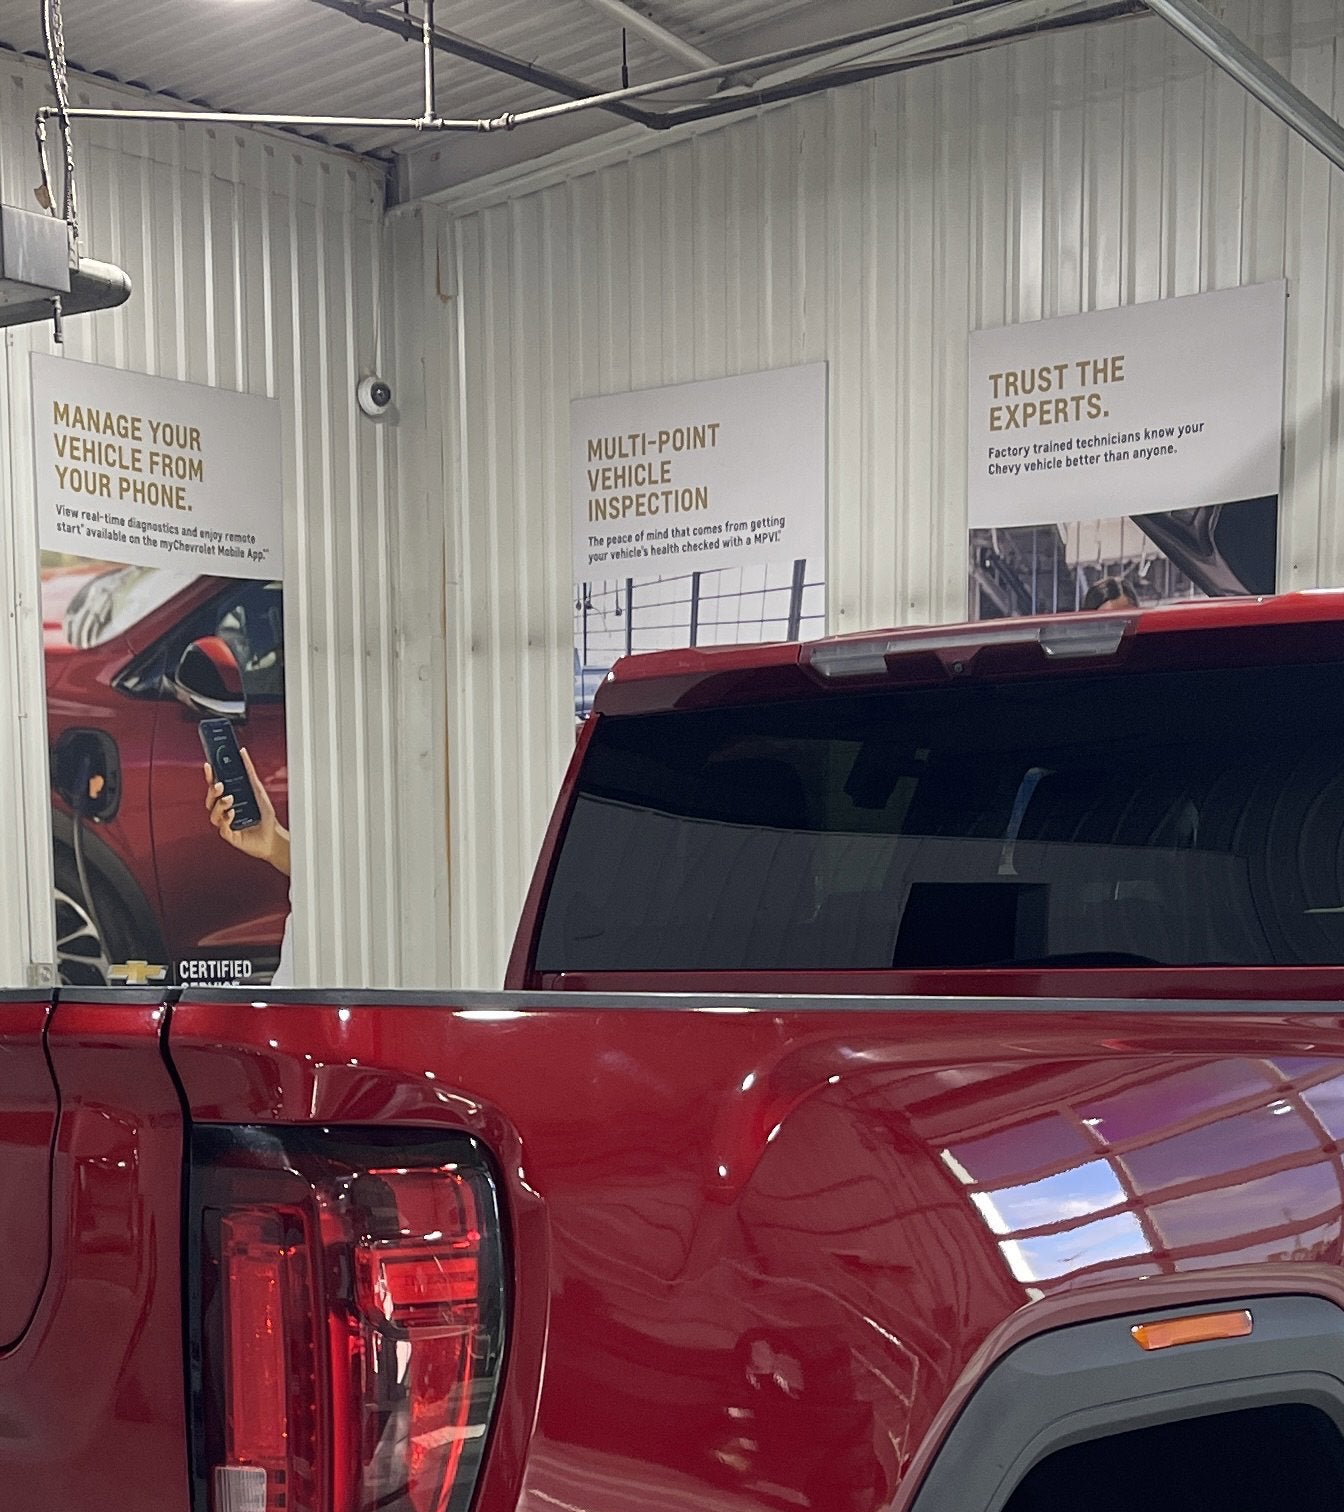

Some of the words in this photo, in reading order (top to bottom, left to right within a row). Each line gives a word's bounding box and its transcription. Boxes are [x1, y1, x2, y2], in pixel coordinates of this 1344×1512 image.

[988, 363, 1069, 399] TRUST
[1075, 355, 1125, 386] THE
[53, 401, 142, 442] MANAGE
[148, 419, 202, 451] YOUR
[989, 392, 1110, 432] EXPERTS.
[53, 432, 143, 473] VEHICLE
[149, 450, 203, 483] FROM
[587, 422, 720, 462] MULTI-POINT
[988, 444, 1030, 461] Factory
[1033, 438, 1073, 455] trained
[1076, 429, 1141, 451] technicians
[1144, 425, 1175, 443] know
[1177, 421, 1205, 439] your
[988, 462, 1021, 476] Chevy
[1024, 455, 1062, 472] vehicle
[1065, 452, 1100, 468] better
[1104, 448, 1130, 464] than
[1132, 442, 1178, 460] anyone.
[55, 464, 111, 498] YOUR
[119, 476, 193, 512] PHONE.
[587, 460, 672, 492] VEHICLE
[588, 486, 708, 522] INSPECTION
[56, 504, 79, 519] View
[81, 509, 125, 527] real-time
[127, 516, 179, 536] diagnostics
[181, 526, 198, 539] and
[200, 529, 223, 544] enjoy
[225, 532, 256, 545] remote
[86, 526, 127, 544] available
[129, 535, 141, 545] on
[142, 535, 158, 548] the
[160, 538, 216, 556] myChevrolet
[218, 544, 245, 559] Mobile
[588, 535, 605, 548] The
[606, 533, 632, 548] peace
[635, 530, 645, 543] of
[646, 528, 669, 542] mind
[671, 526, 690, 539] that
[693, 524, 723, 537] comes
[725, 520, 748, 533] from
[751, 516, 786, 531] getting
[588, 551, 608, 565] your
[610, 545, 648, 560] vehicle's
[650, 542, 680, 556] health
[682, 539, 720, 553] checked
[722, 535, 744, 548] with
[746, 536, 752, 545] a
[179, 960, 252, 979] CERTIFIED
